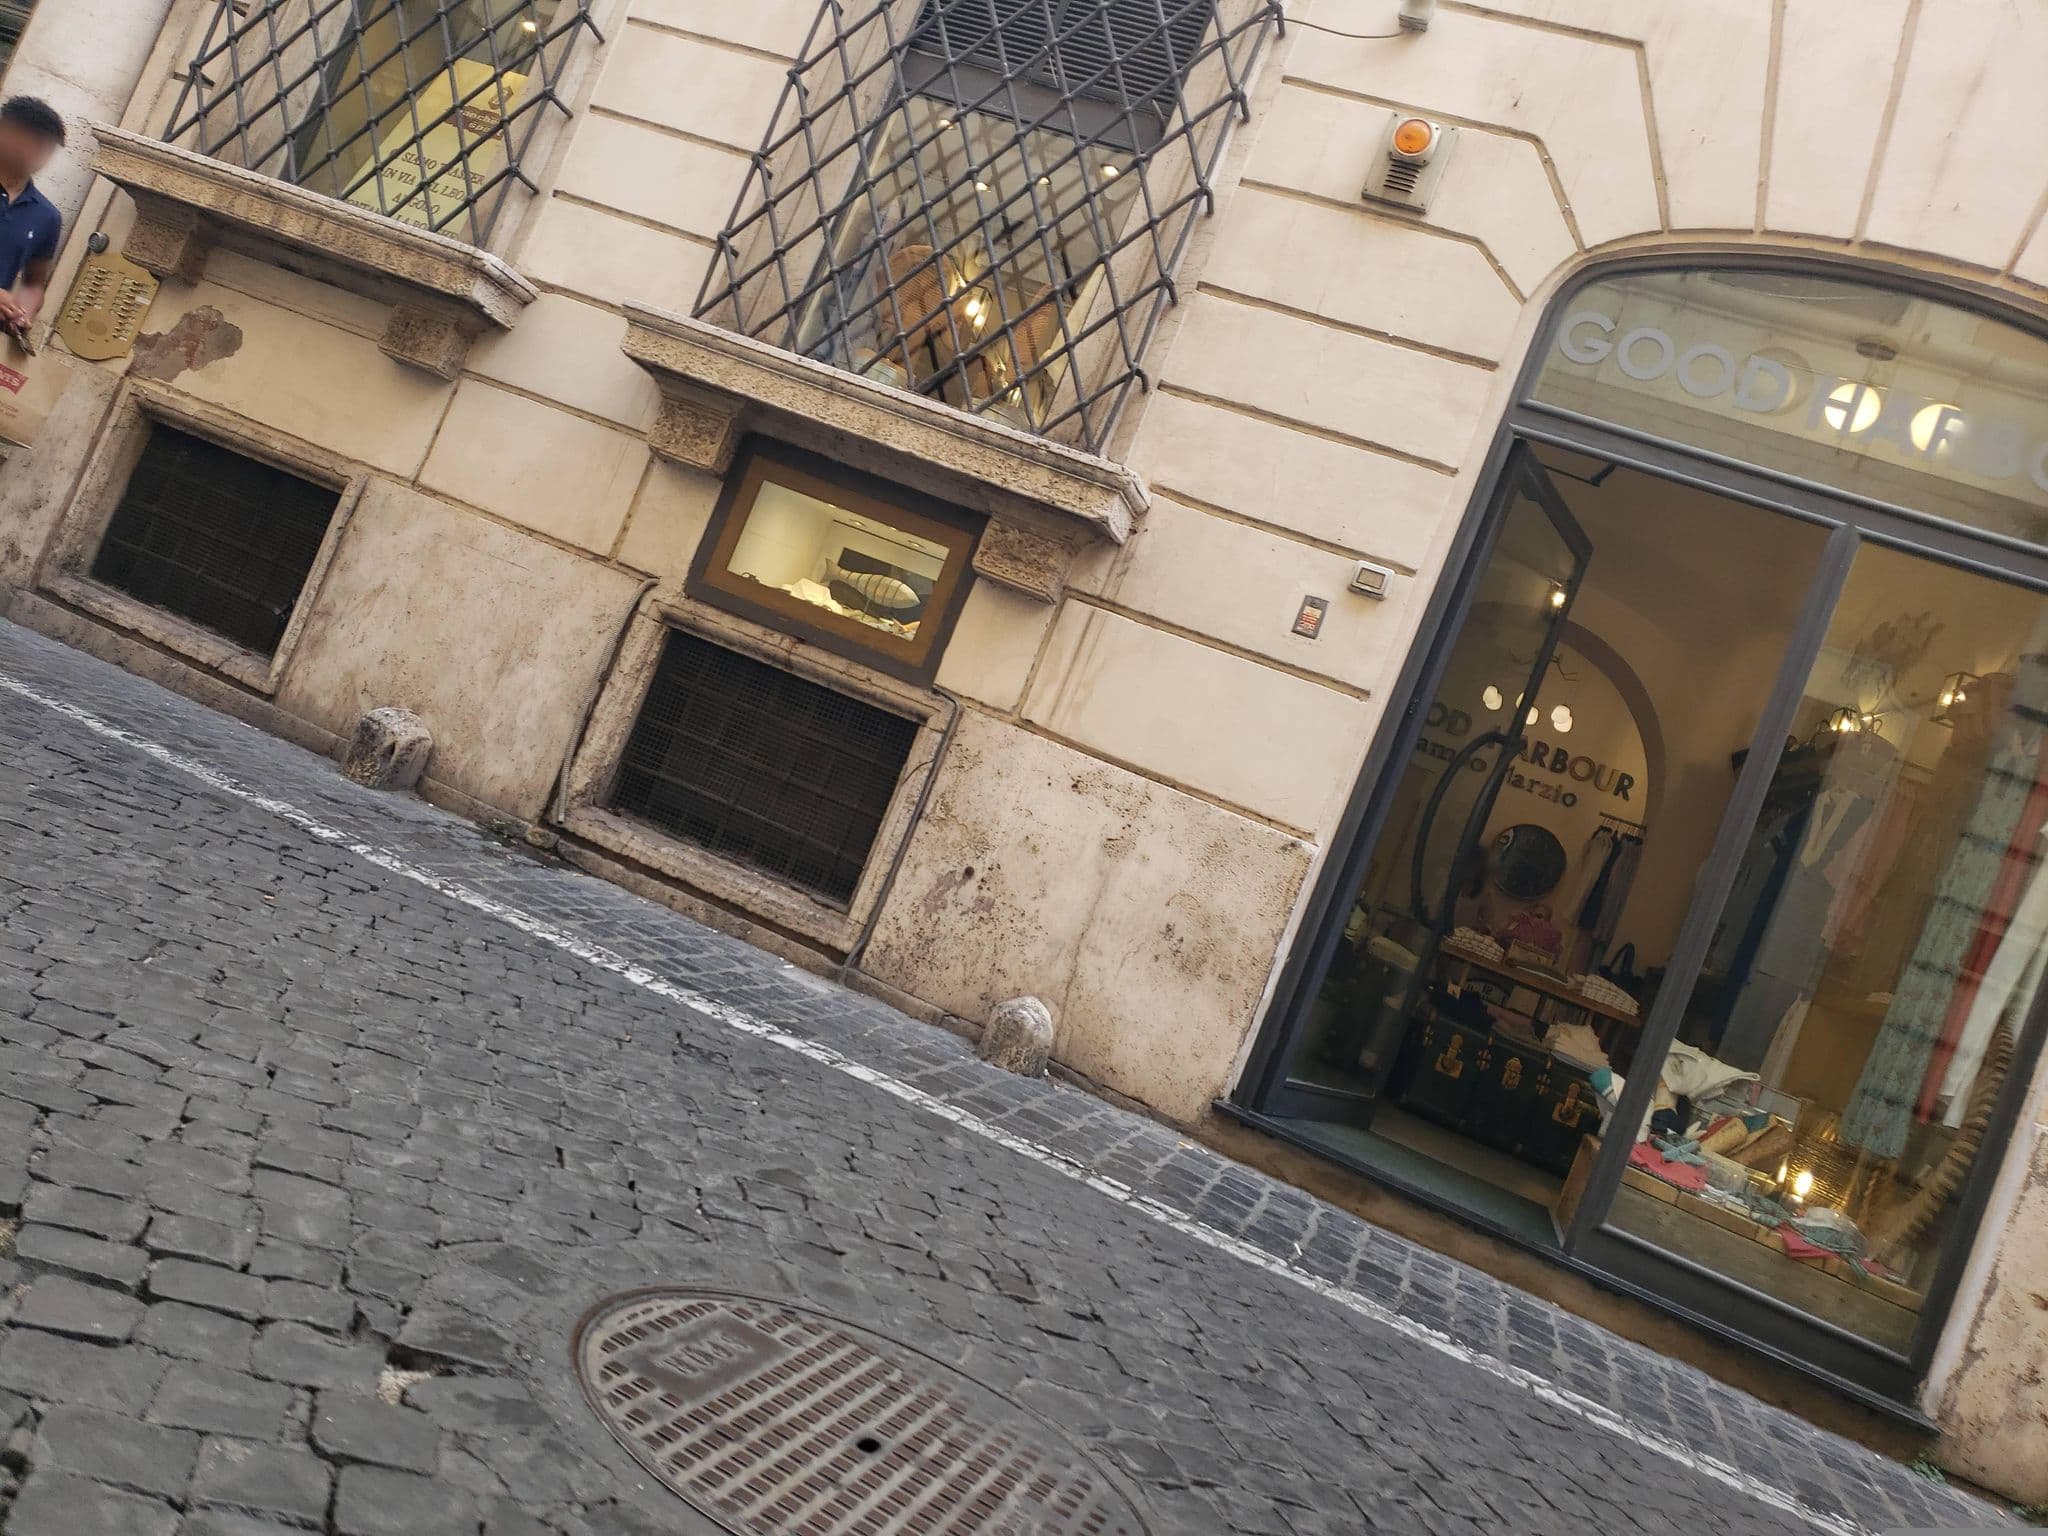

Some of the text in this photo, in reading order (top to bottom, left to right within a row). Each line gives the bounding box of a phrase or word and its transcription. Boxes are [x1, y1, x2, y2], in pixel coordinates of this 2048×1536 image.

[382, 167, 398, 180] IN
[397, 170, 416, 186] VIA
[1557, 311, 1796, 414] GOOD
